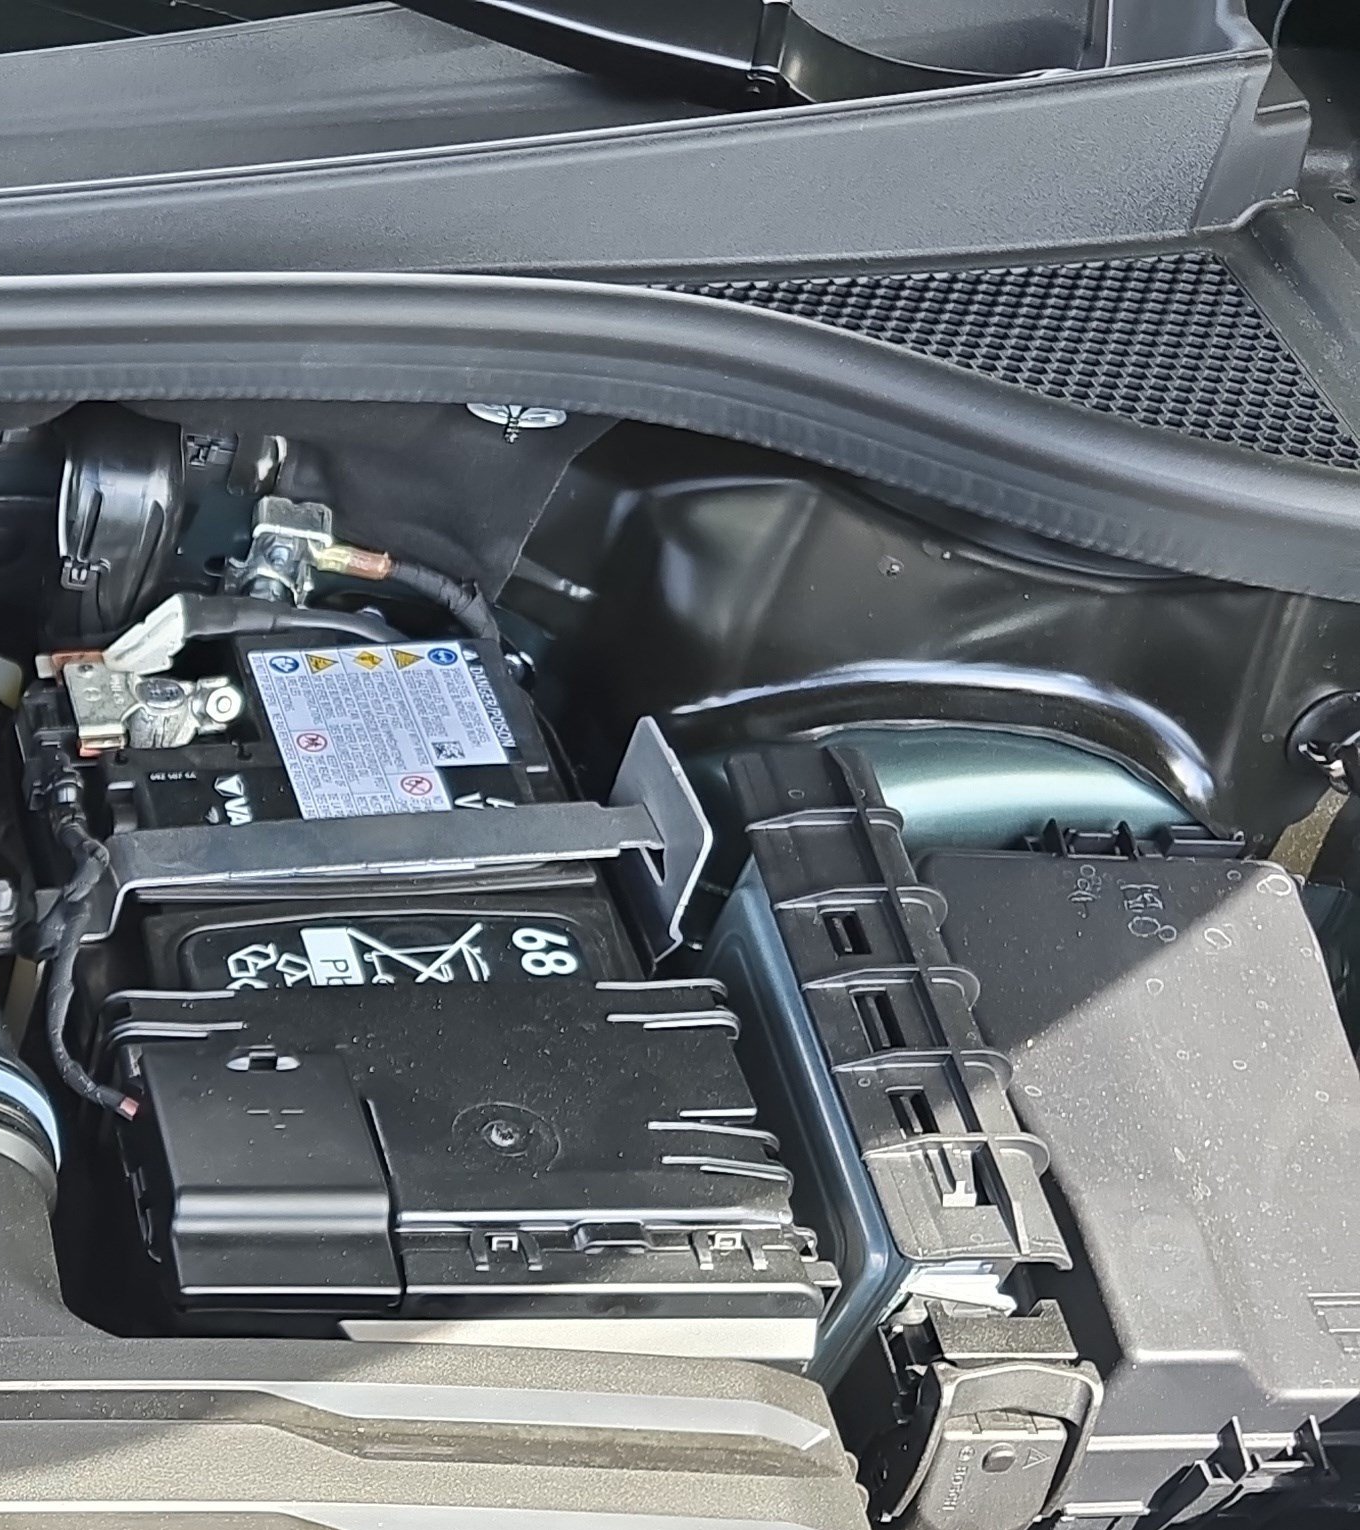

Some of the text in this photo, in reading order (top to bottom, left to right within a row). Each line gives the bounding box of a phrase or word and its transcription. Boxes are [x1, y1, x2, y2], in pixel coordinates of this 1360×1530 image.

[468, 666, 516, 747] DANGER/POISON
[512, 928, 578, 976] 68
[941, 1465, 969, 1511] BOSCH
